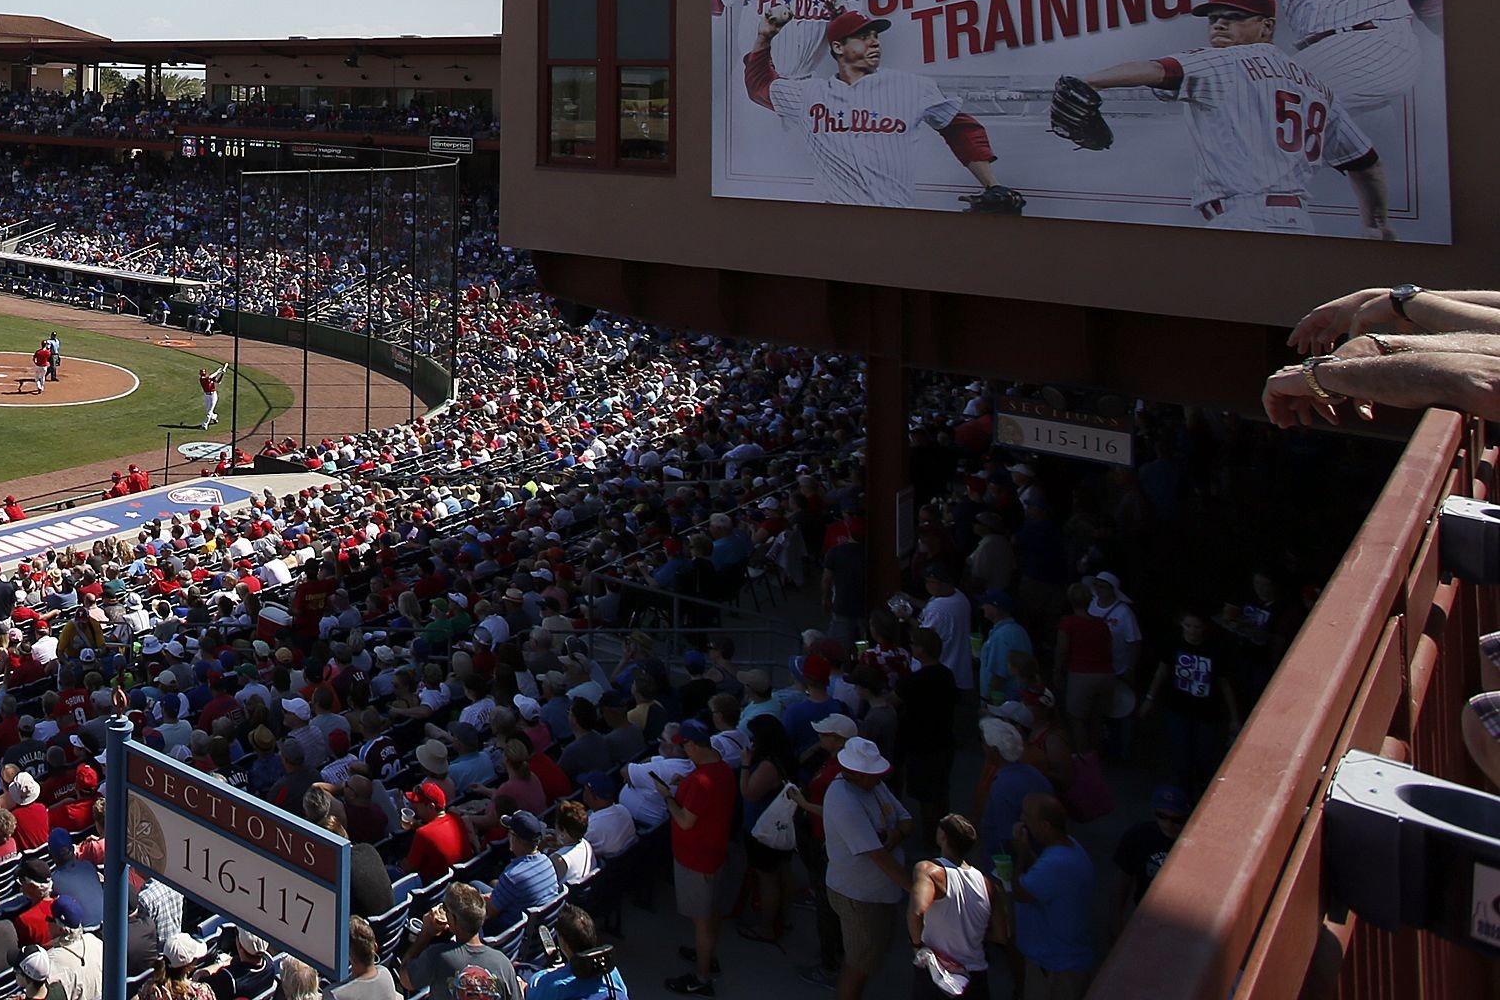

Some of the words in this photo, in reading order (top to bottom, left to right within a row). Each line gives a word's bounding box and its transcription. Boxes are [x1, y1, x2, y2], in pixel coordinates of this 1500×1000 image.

[809, 103, 907, 134] Phillies
[1276, 89, 1327, 163] 58
[1033, 427, 1117, 455] 115-116
[144, 765, 316, 867] SECTIONS
[183, 838, 315, 935] 116-117
